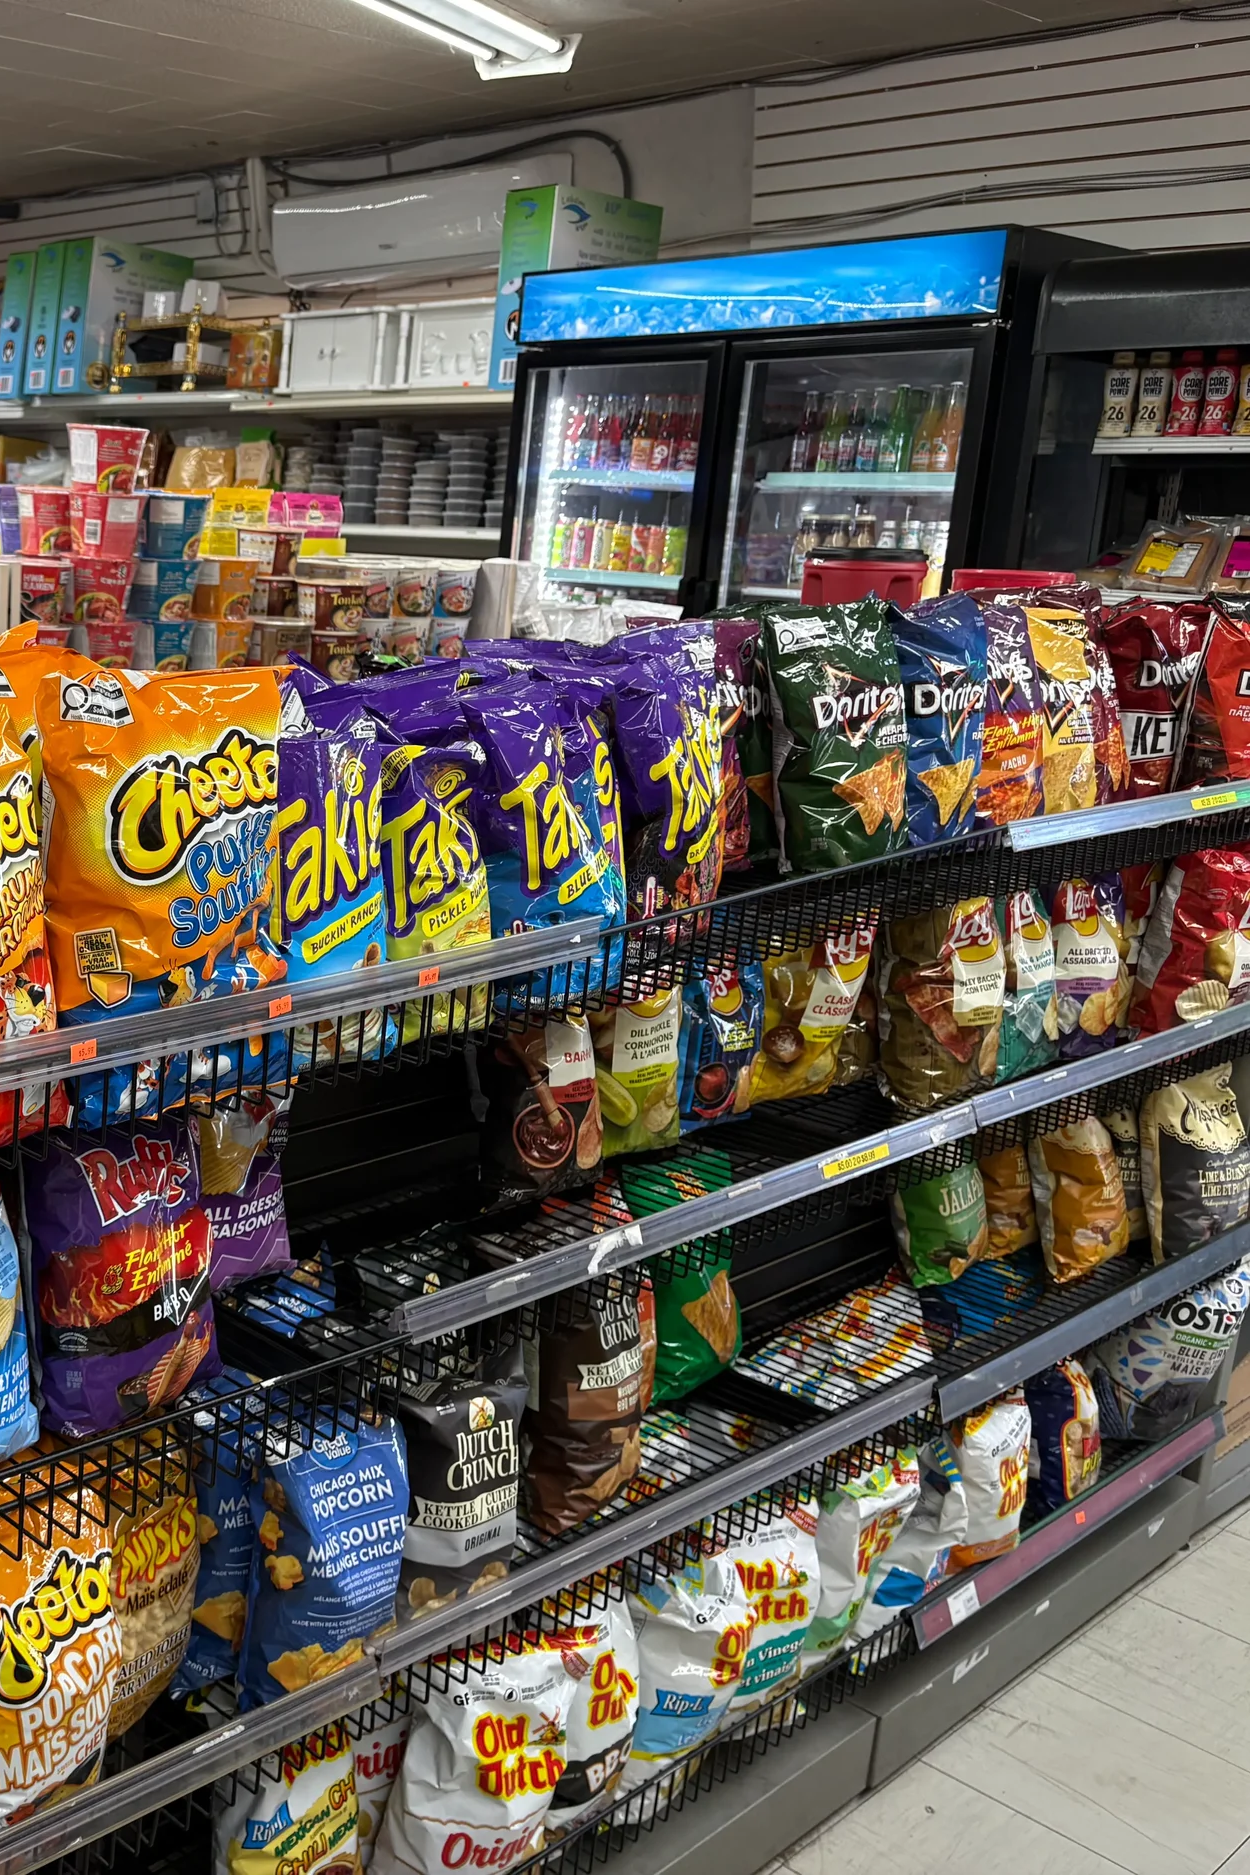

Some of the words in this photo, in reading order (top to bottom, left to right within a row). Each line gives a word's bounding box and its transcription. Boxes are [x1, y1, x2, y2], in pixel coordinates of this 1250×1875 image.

[1110, 377, 1131, 388] CORE
[1144, 377, 1164, 387] CORE
[1184, 378, 1203, 388] CORE
[1209, 377, 1230, 387] CORE
[1000, 754, 1027, 771] NACHO
[566, 866, 594, 900] BLUE
[428, 899, 468, 932] PICKLE
[310, 916, 349, 956] BUCKIN'
[1068, 947, 1083, 956] ALL
[82, 962, 116, 972] FROMAGE
[977, 973, 1002, 986] BACON
[979, 981, 1000, 994] FUMÉ
[275, 1001, 291, 1013] $5.99
[629, 1026, 649, 1039] DILL
[78, 1046, 96, 1058] $5.99
[204, 1205, 237, 1225] ALL
[1175, 1333, 1208, 1346] ORGANIC
[1178, 1346, 1208, 1361] BLUE
[455, 1418, 515, 1463] DUTCH
[446, 1445, 520, 1492] CRUNCH
[308, 1472, 357, 1500] CHICAGO
[358, 1463, 386, 1483] MIX
[312, 1479, 394, 1522] POPCORN
[423, 1500, 477, 1517] KETTLE
[422, 1513, 480, 1531] COOKED
[306, 1532, 341, 1564] MAÏS
[464, 1525, 502, 1552] ORIGINAL
[310, 1550, 360, 1580] MÉLANGE
[126, 1588, 157, 1618] Maïs
[157, 1567, 190, 1601] éclaté
[116, 1649, 155, 1683] ALTED
[153, 1625, 190, 1658] TOFFEE
[475, 1714, 528, 1760] Old
[477, 1750, 567, 1799] Dutch
[275, 1832, 328, 1875] CHILI
